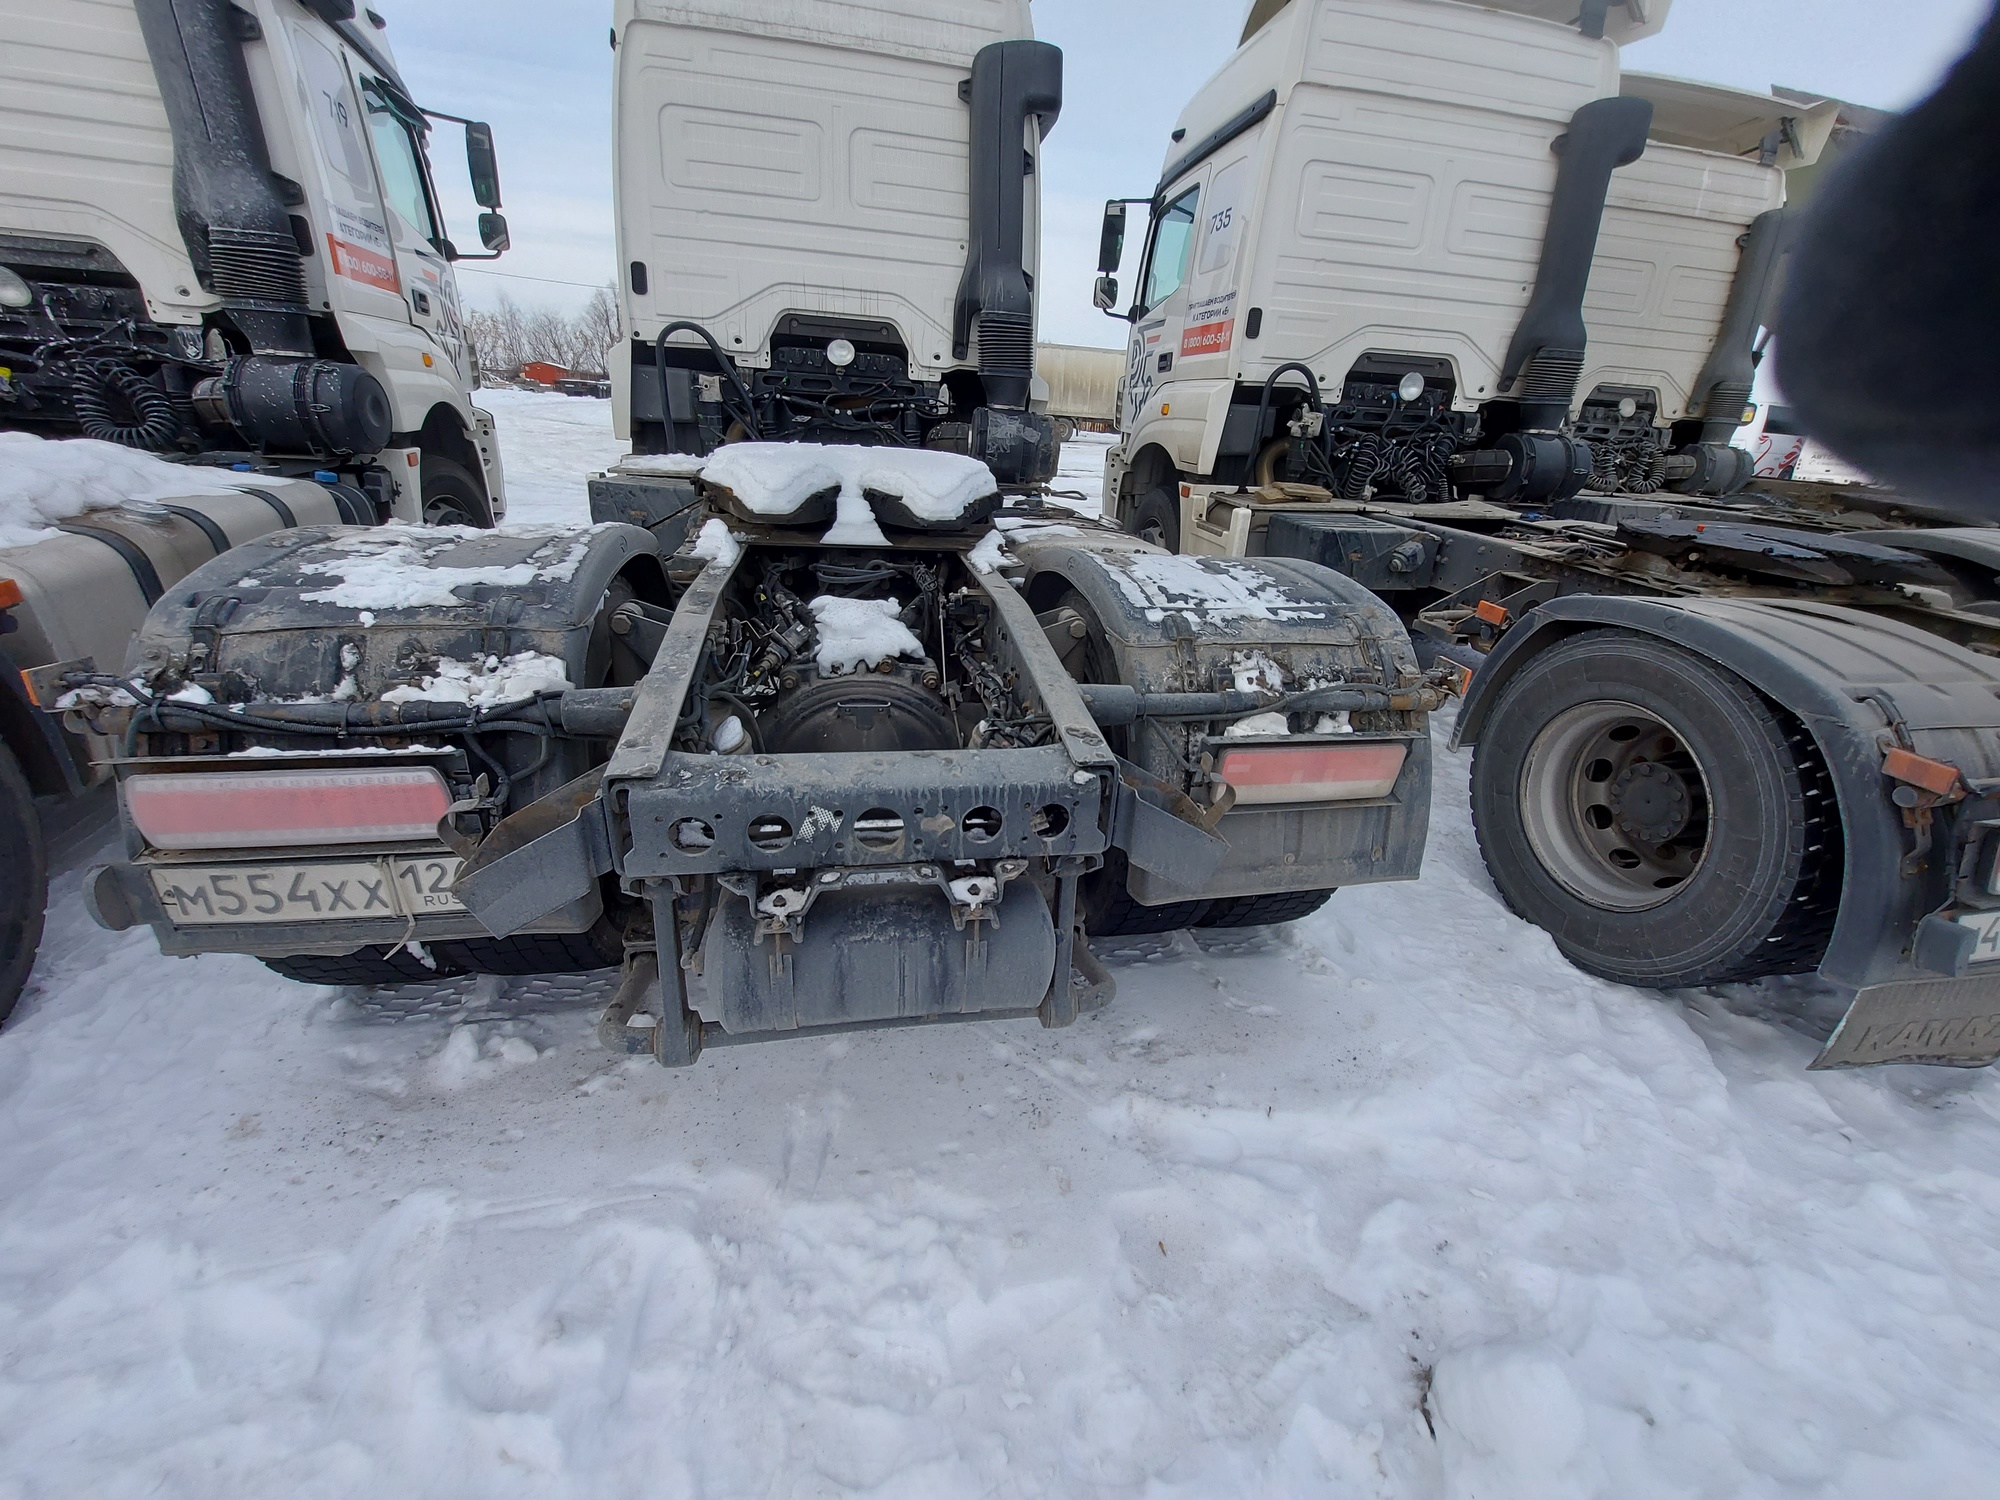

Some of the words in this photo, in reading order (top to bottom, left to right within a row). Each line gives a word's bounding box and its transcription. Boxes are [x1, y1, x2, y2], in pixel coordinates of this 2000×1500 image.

[322, 90, 348, 128] 719
[1210, 207, 1232, 234] 735
[1188, 298, 1214, 311] ПРИГЛАШАЕМ
[1214, 289, 1237, 305] ВОДИТЕЛЕЙ
[1192, 307, 1222, 322] КАТЕГОРИИ
[399, 860, 467, 895] 12
